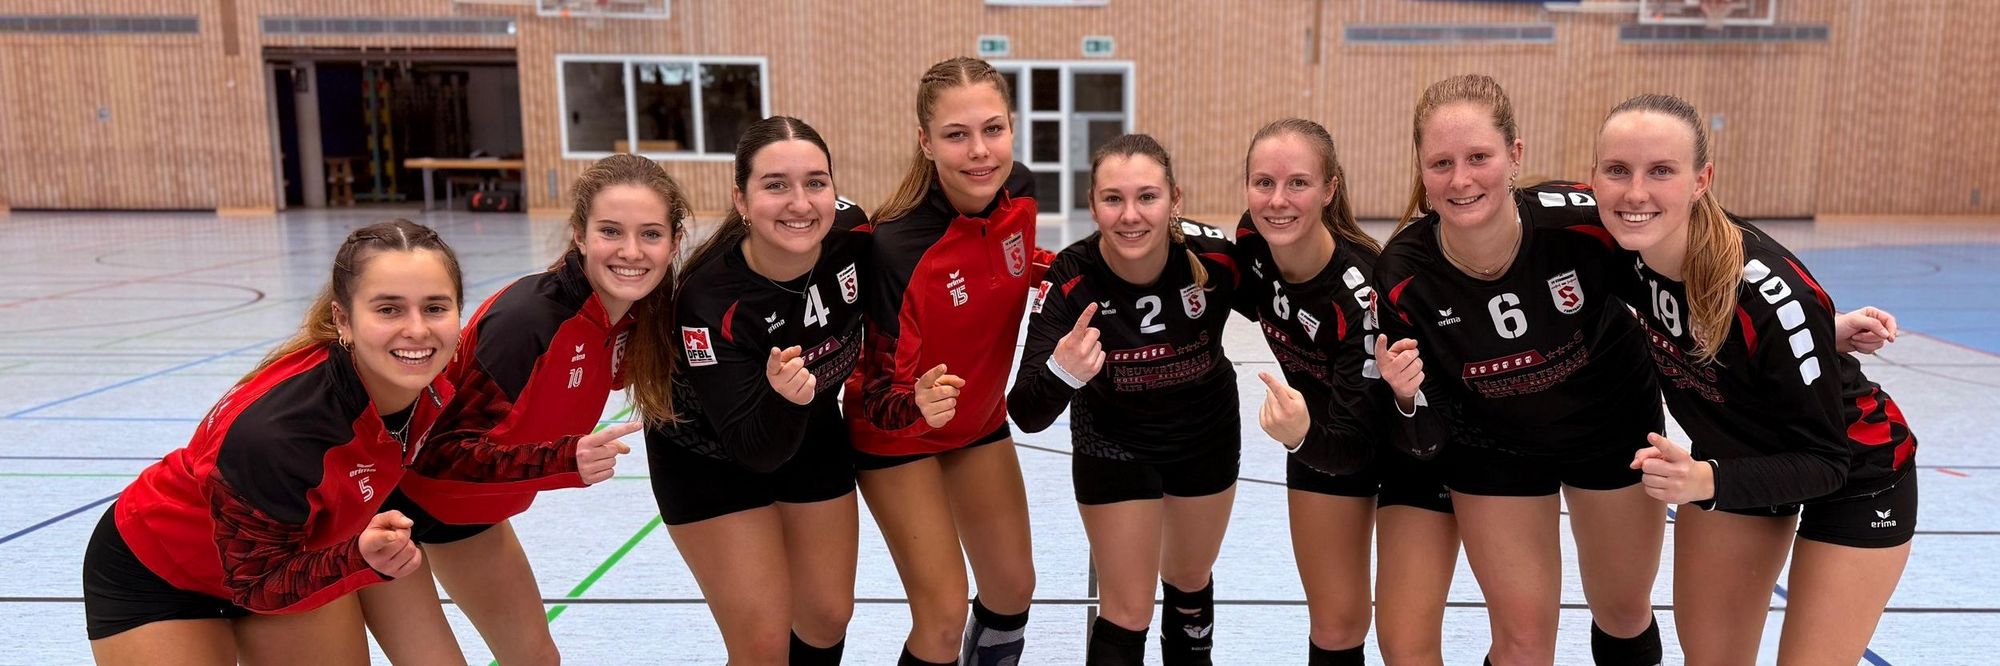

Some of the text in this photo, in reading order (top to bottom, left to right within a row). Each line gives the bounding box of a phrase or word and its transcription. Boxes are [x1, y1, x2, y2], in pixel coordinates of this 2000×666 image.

[946, 277, 965, 289] erima
[803, 284, 830, 328] 4
[949, 285, 969, 307] 15
[1558, 286, 1580, 307] S
[1135, 295, 1166, 334] 2
[1487, 292, 1528, 339] 6
[1649, 279, 1683, 338] 19
[767, 318, 786, 335] erima
[1437, 316, 1462, 327] erima
[688, 350, 712, 358] DFBL
[567, 367, 583, 389] 10
[349, 467, 377, 478] erima
[358, 476, 374, 503] 5
[1871, 519, 1897, 529] erima
